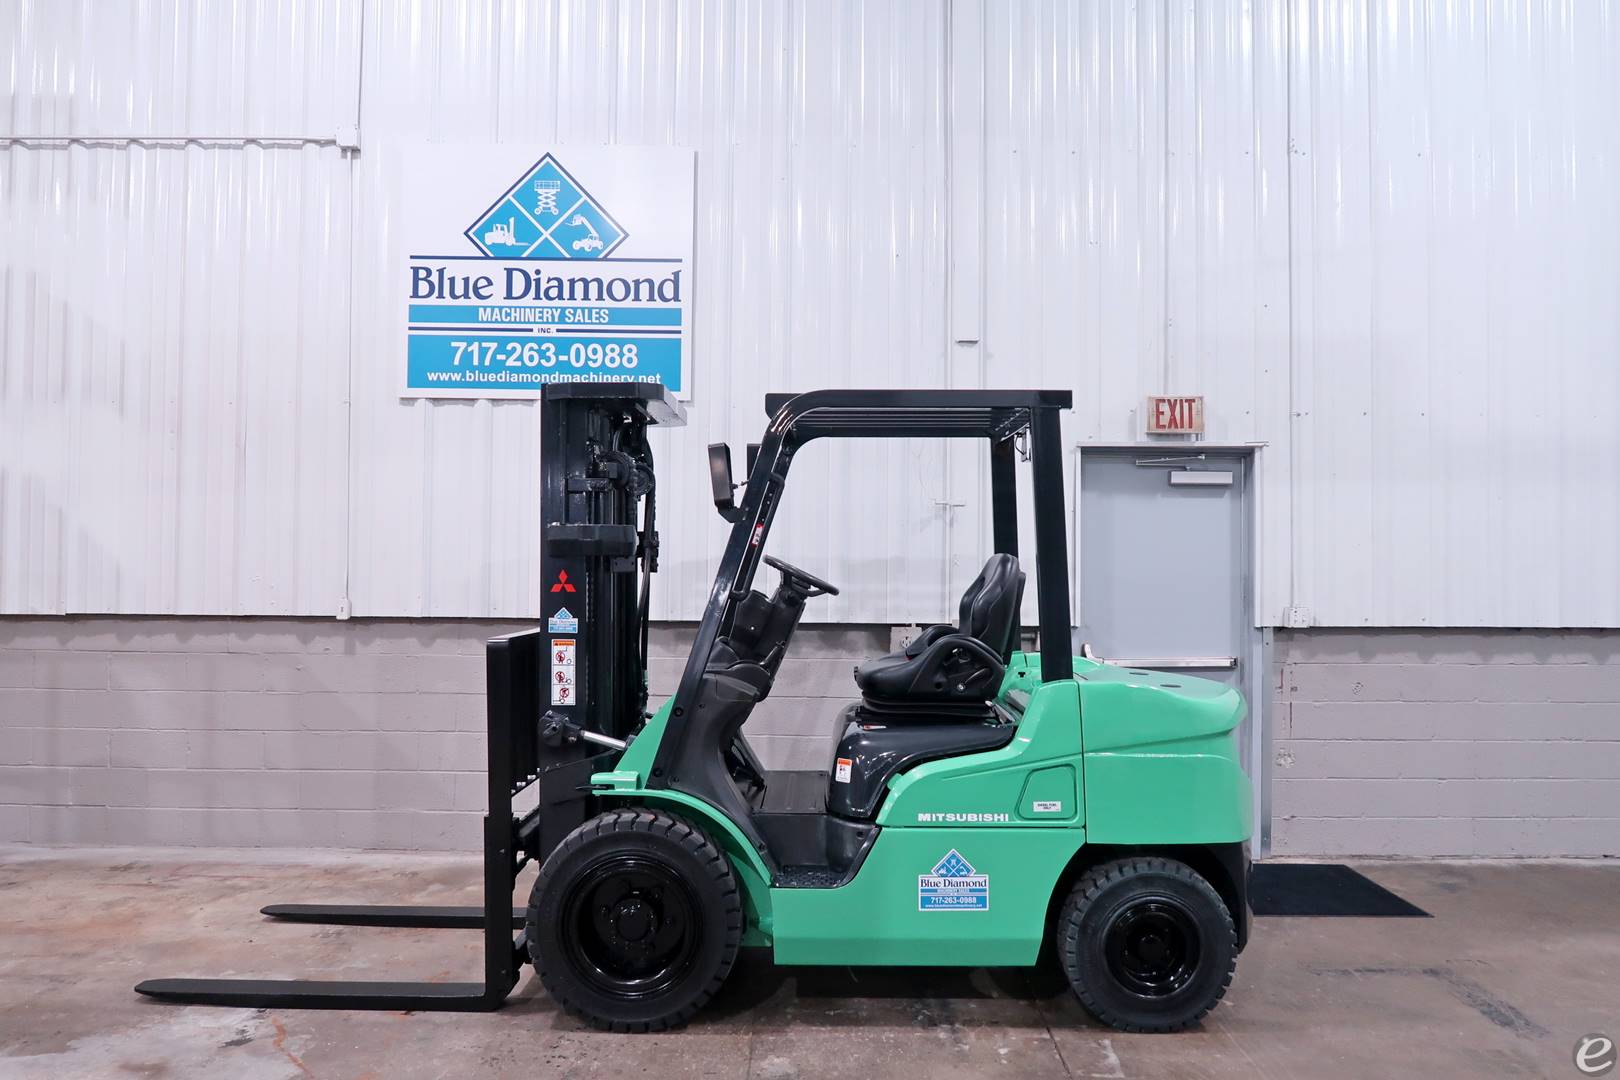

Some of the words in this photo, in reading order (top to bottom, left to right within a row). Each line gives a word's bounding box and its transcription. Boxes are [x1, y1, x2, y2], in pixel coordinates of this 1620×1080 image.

[409, 266, 494, 300] Blue
[503, 267, 682, 303] Diamond
[478, 307, 560, 323] MACHINERY
[564, 309, 609, 324] SALES
[537, 327, 554, 335] INC.
[450, 341, 639, 369] 717-263-0988
[427, 370, 662, 385] www.bluediamondmachinery.net
[1155, 398, 1196, 429] EXIT
[918, 813, 1009, 822] MITSUBISHI
[920, 878, 942, 888] Blue
[943, 878, 987, 888] Diamond
